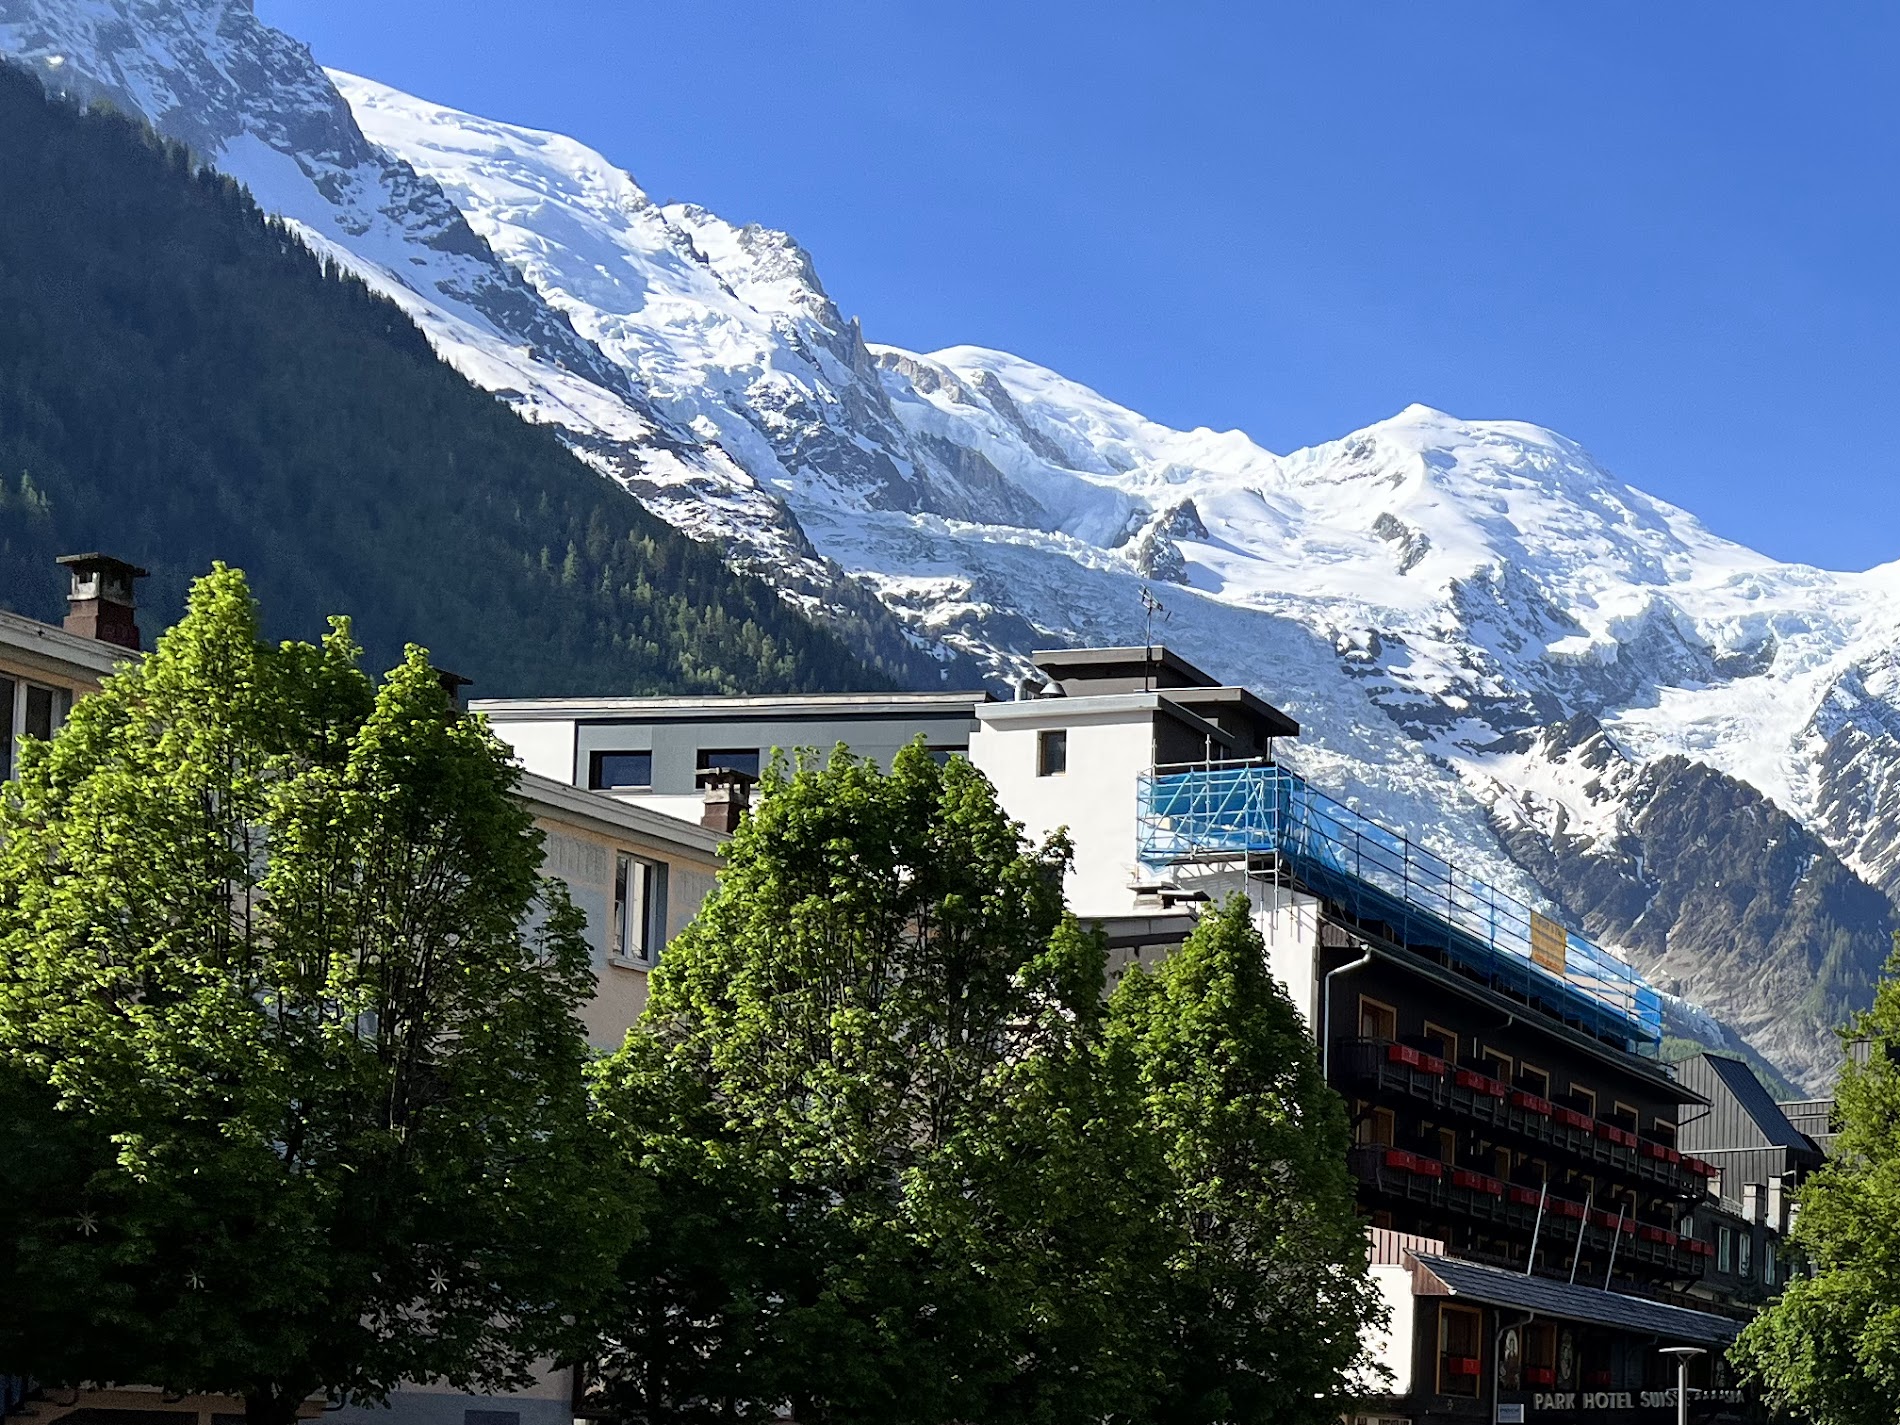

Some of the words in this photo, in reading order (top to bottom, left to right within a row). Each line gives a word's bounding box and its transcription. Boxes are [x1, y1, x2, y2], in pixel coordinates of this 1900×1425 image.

[1533, 1393, 1576, 1410] PARK
[1582, 1392, 1635, 1409] HOTEL
[1640, 1391, 1691, 1408] SUIS
